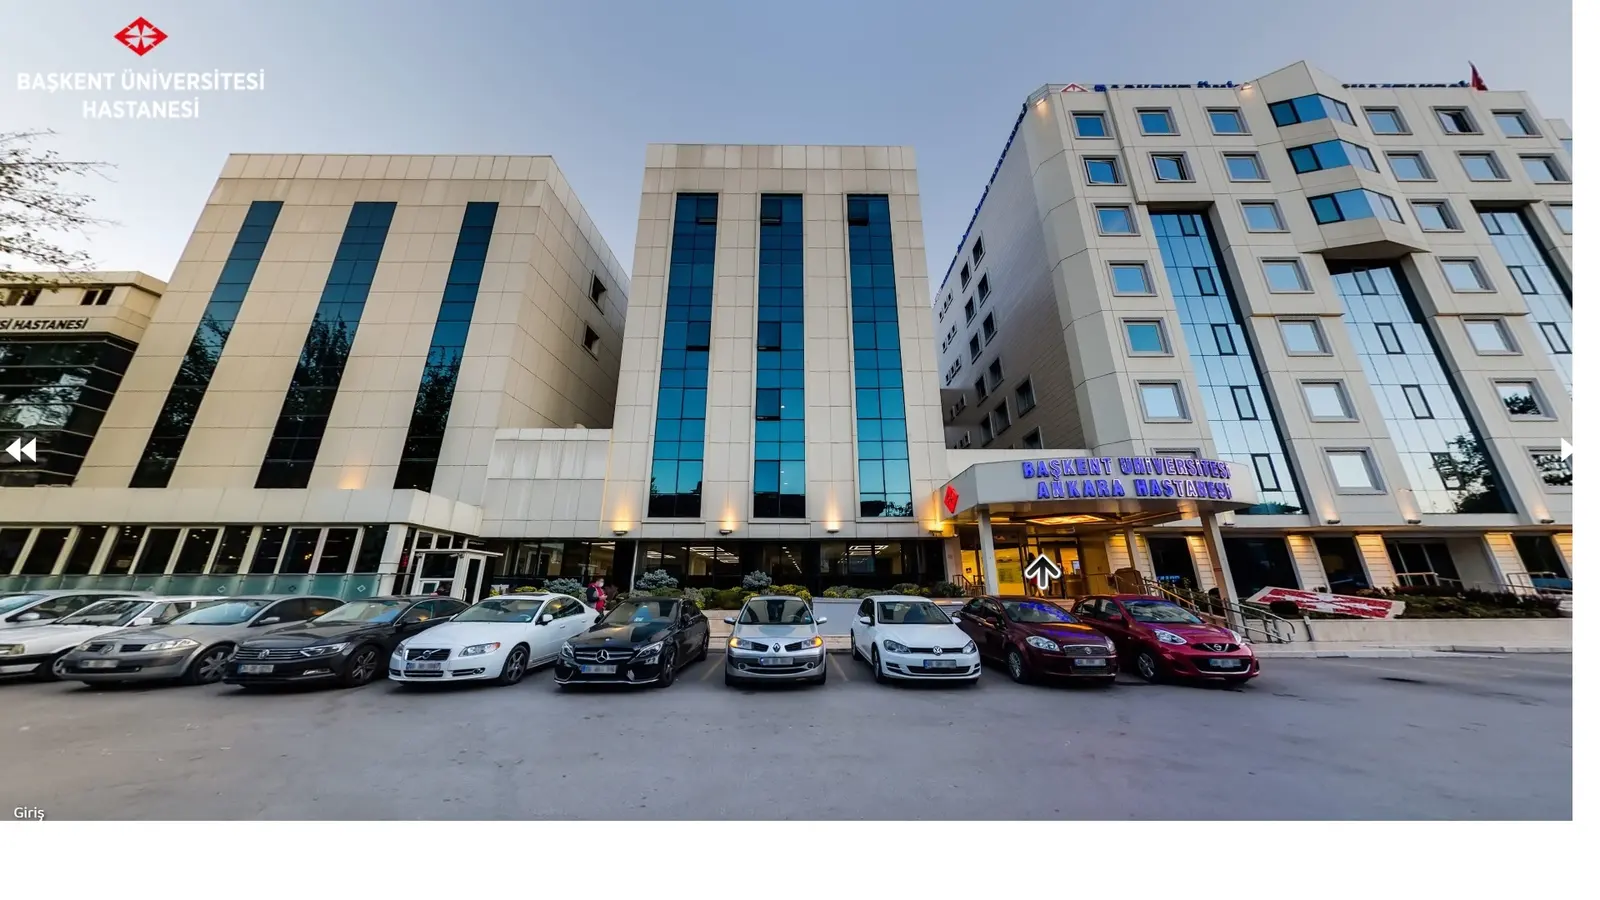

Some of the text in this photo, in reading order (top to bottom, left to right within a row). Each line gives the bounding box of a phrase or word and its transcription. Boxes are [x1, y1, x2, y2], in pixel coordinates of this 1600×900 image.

[1022, 457, 1112, 481] BAŞKENT
[1037, 479, 1233, 499] ANKARA HASTANESİ
